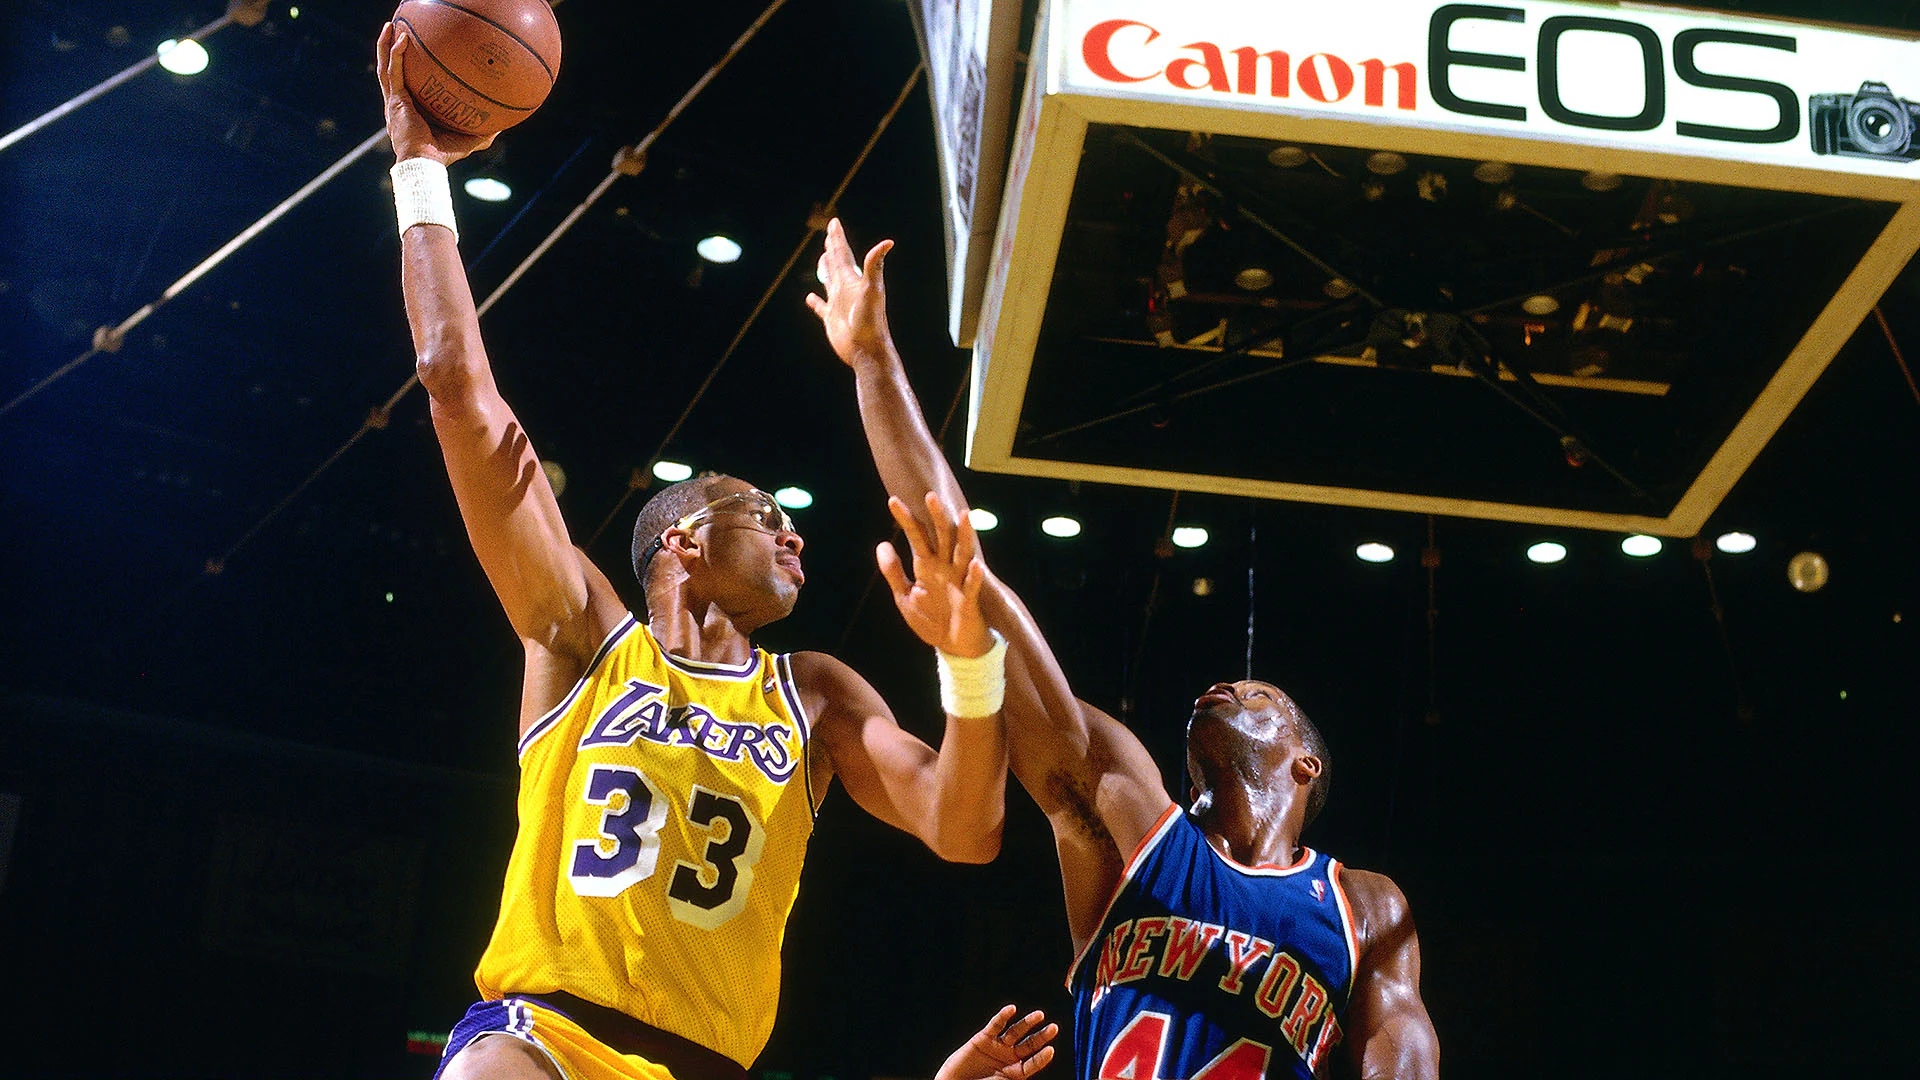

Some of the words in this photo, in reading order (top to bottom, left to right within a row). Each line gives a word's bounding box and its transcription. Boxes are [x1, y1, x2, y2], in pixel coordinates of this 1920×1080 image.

[417, 75, 475, 125] NBA
[1082, 19, 1416, 111] Canon
[1429, 3, 1801, 144] EOS
[577, 677, 801, 786] LAKERS
[567, 763, 767, 931] 33
[1090, 915, 1225, 1012] NEW
[1218, 929, 1344, 1075] YORK
